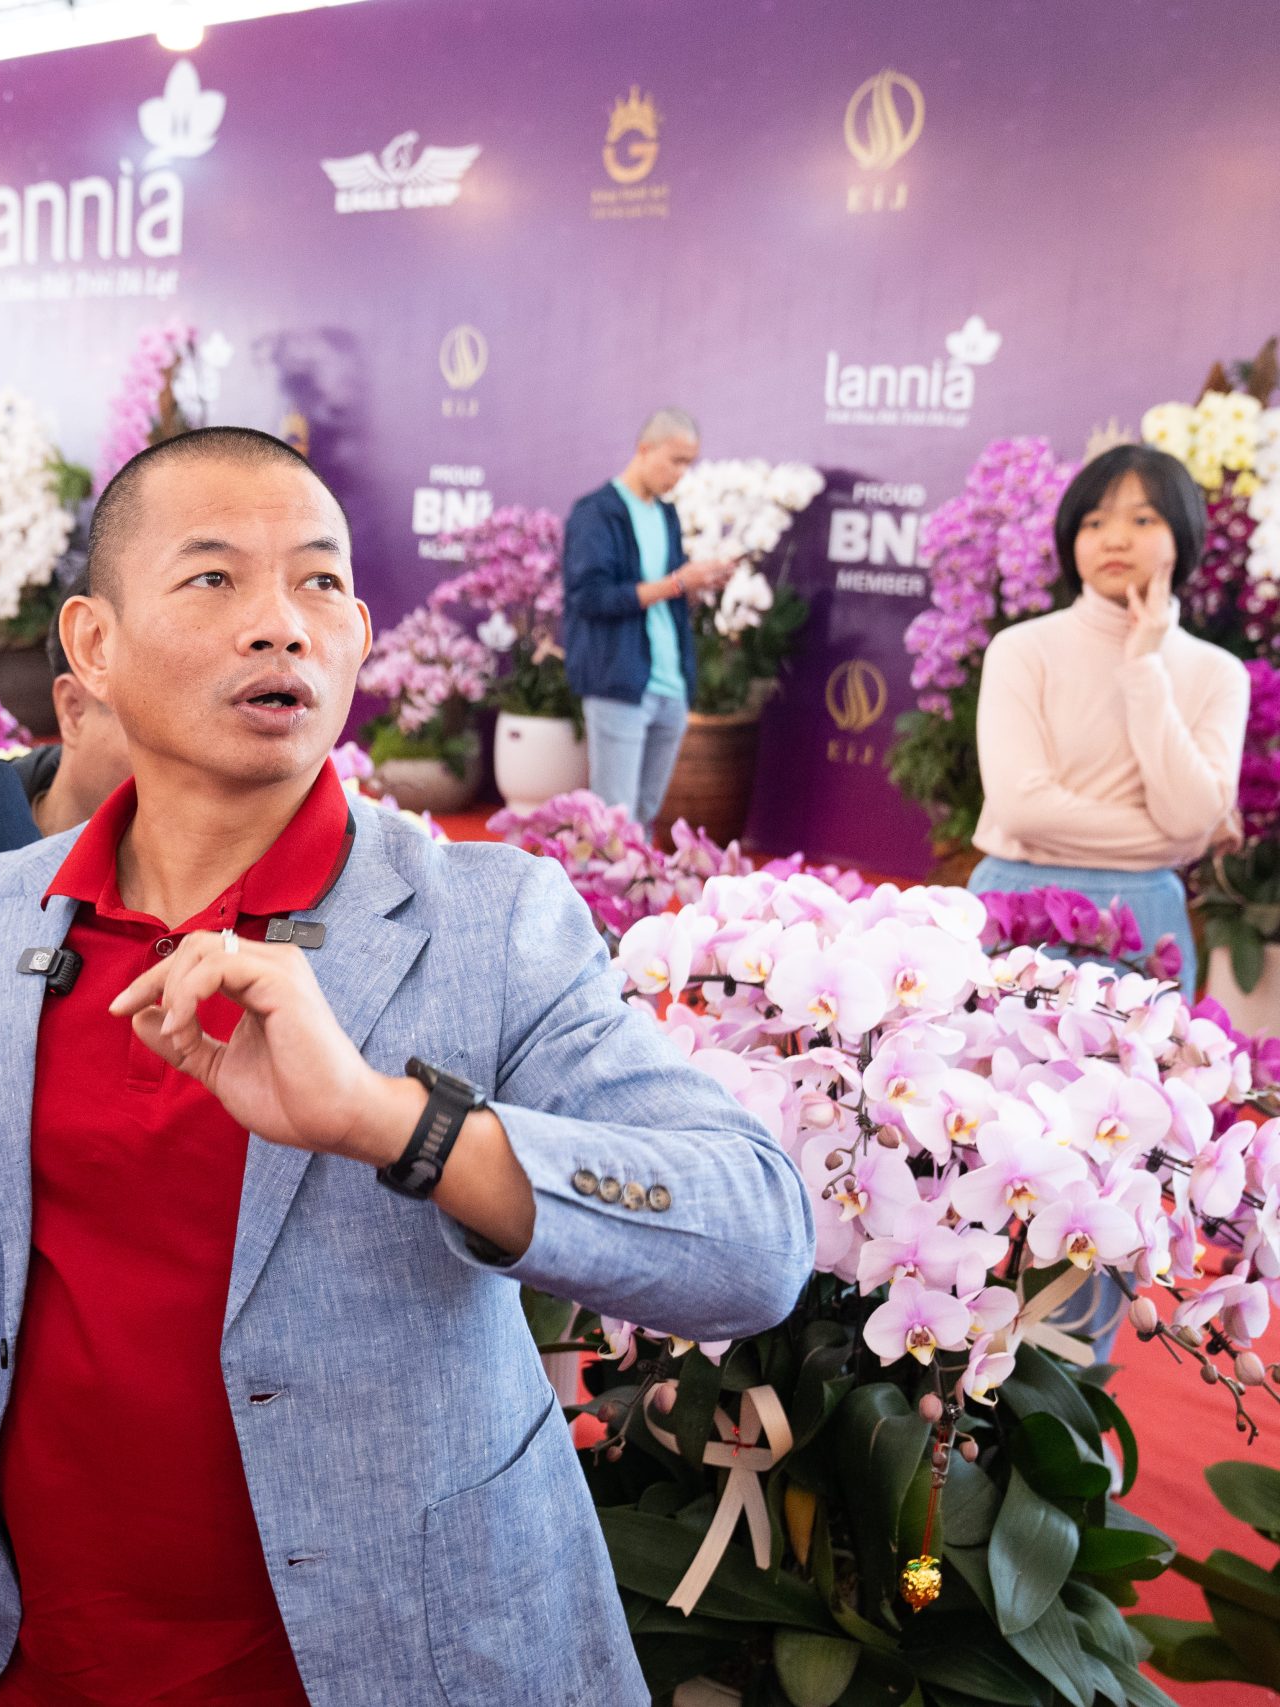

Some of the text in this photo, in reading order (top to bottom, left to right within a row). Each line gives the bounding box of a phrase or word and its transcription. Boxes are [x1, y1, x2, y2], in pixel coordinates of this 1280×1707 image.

[824, 350, 975, 411] lannia
[852, 482, 926, 507] PROUD
[835, 568, 926, 598] MEMBER
